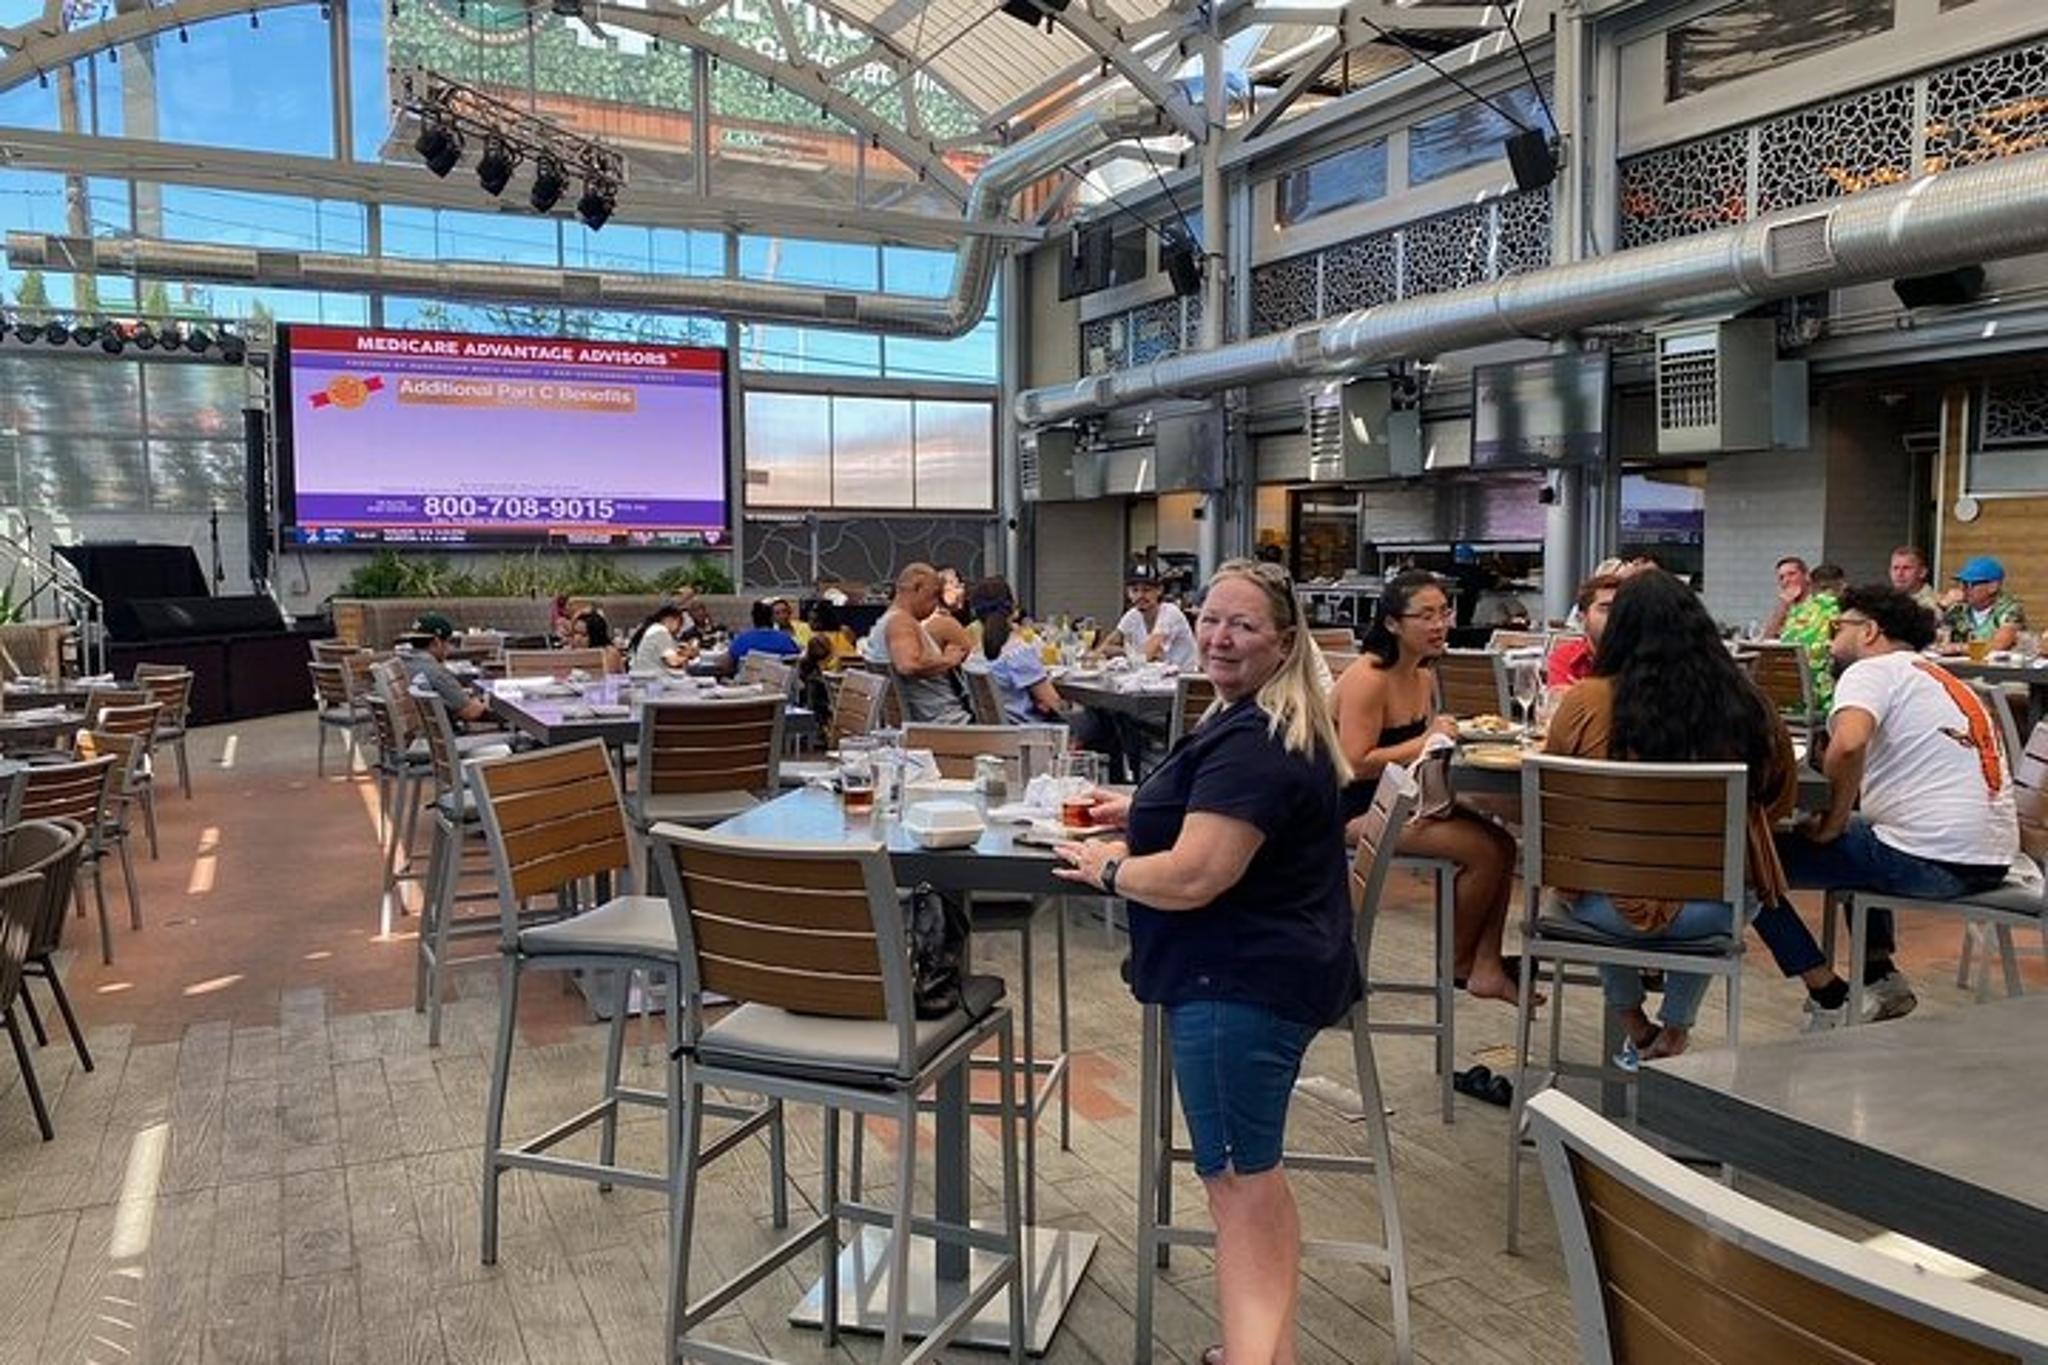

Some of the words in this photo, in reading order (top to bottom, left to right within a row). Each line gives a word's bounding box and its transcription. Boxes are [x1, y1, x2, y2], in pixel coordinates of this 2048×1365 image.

[357, 336, 459, 354] MEDICARE
[464, 343, 574, 361] ADVANTAGE
[400, 379, 493, 397] Additional
[497, 383, 535, 399] Part
[539, 385, 553, 400] C
[559, 386, 632, 404] Benefits
[424, 495, 615, 519] 800-708-9015
